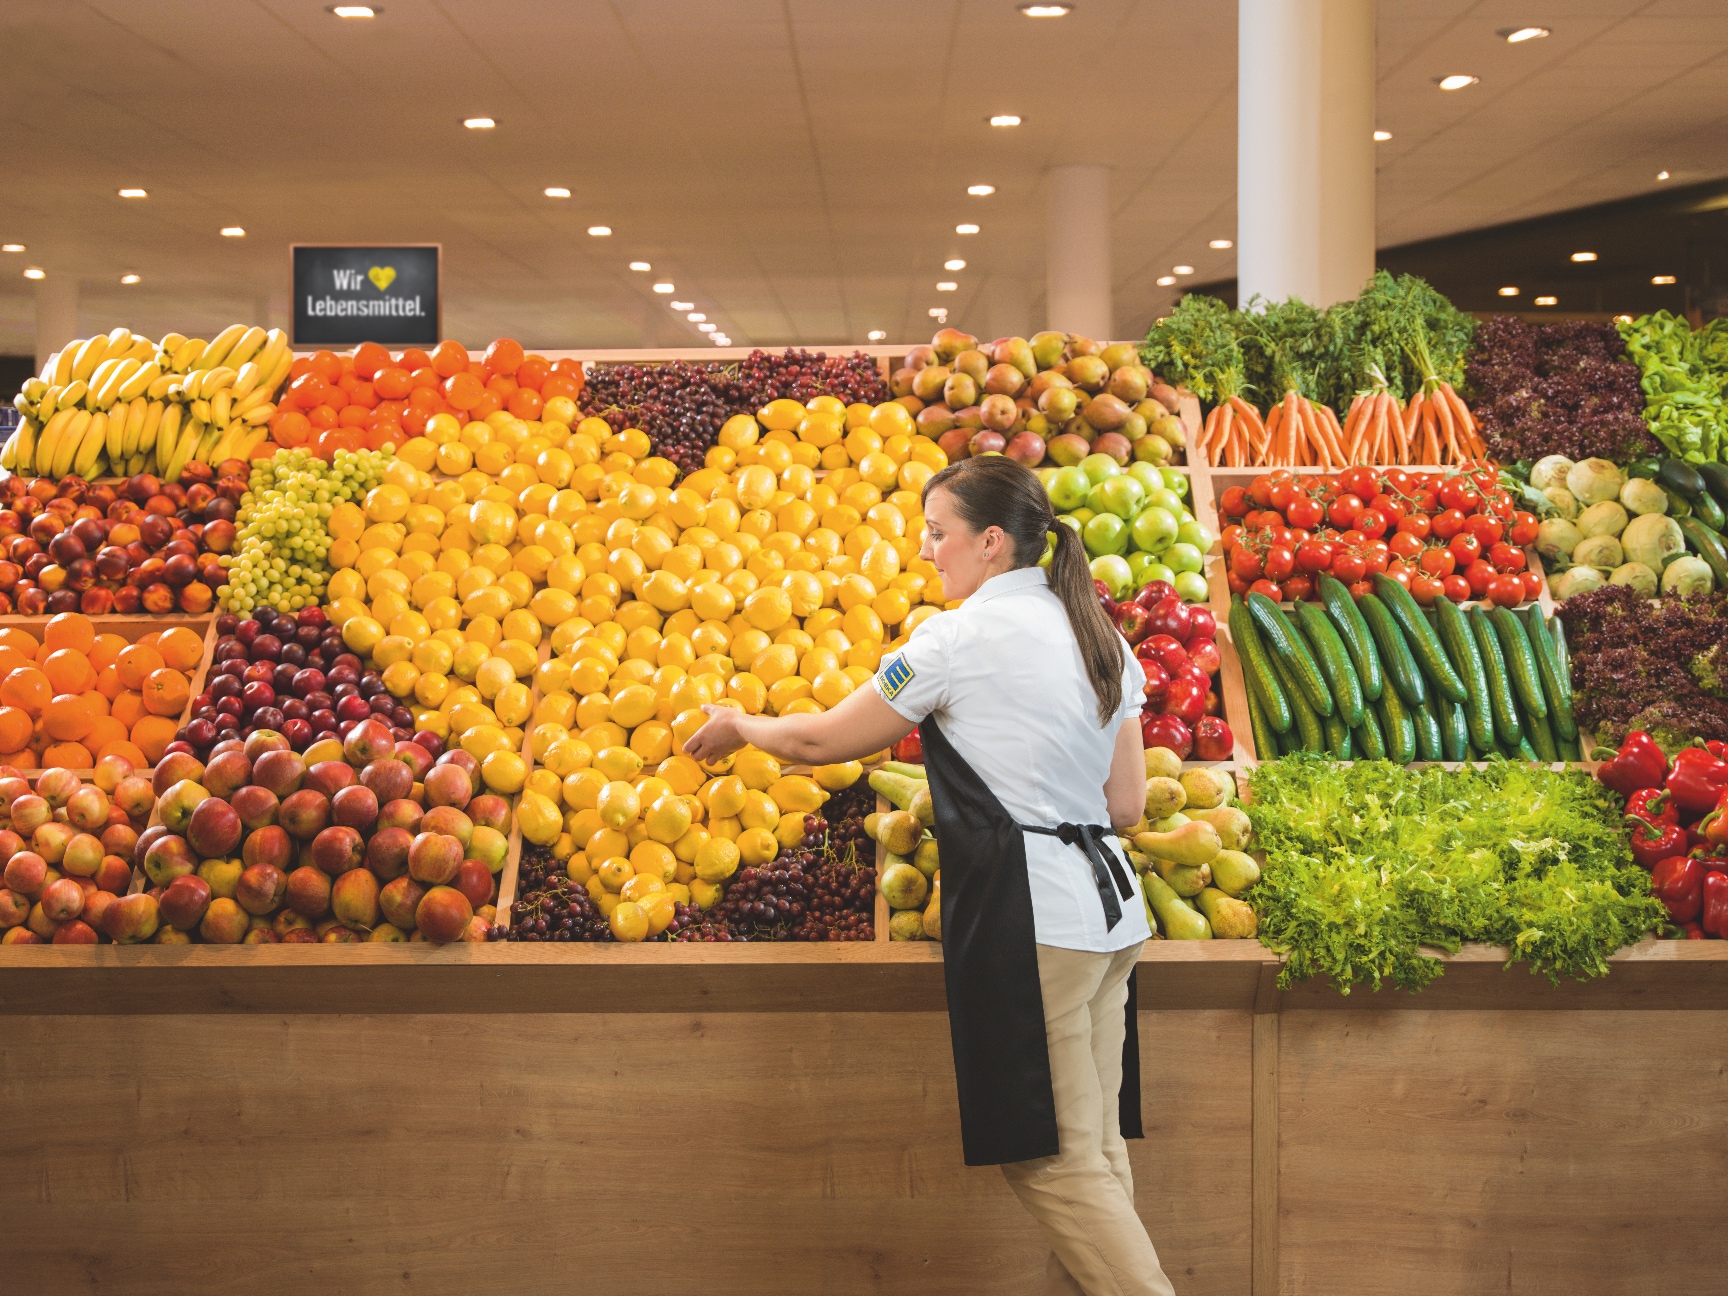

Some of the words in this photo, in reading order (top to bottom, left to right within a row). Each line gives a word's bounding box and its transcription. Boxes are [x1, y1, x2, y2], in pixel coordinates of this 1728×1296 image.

[332, 269, 364, 291] Wir
[307, 295, 426, 317] Lebensmittel.
[884, 656, 911, 691] E
